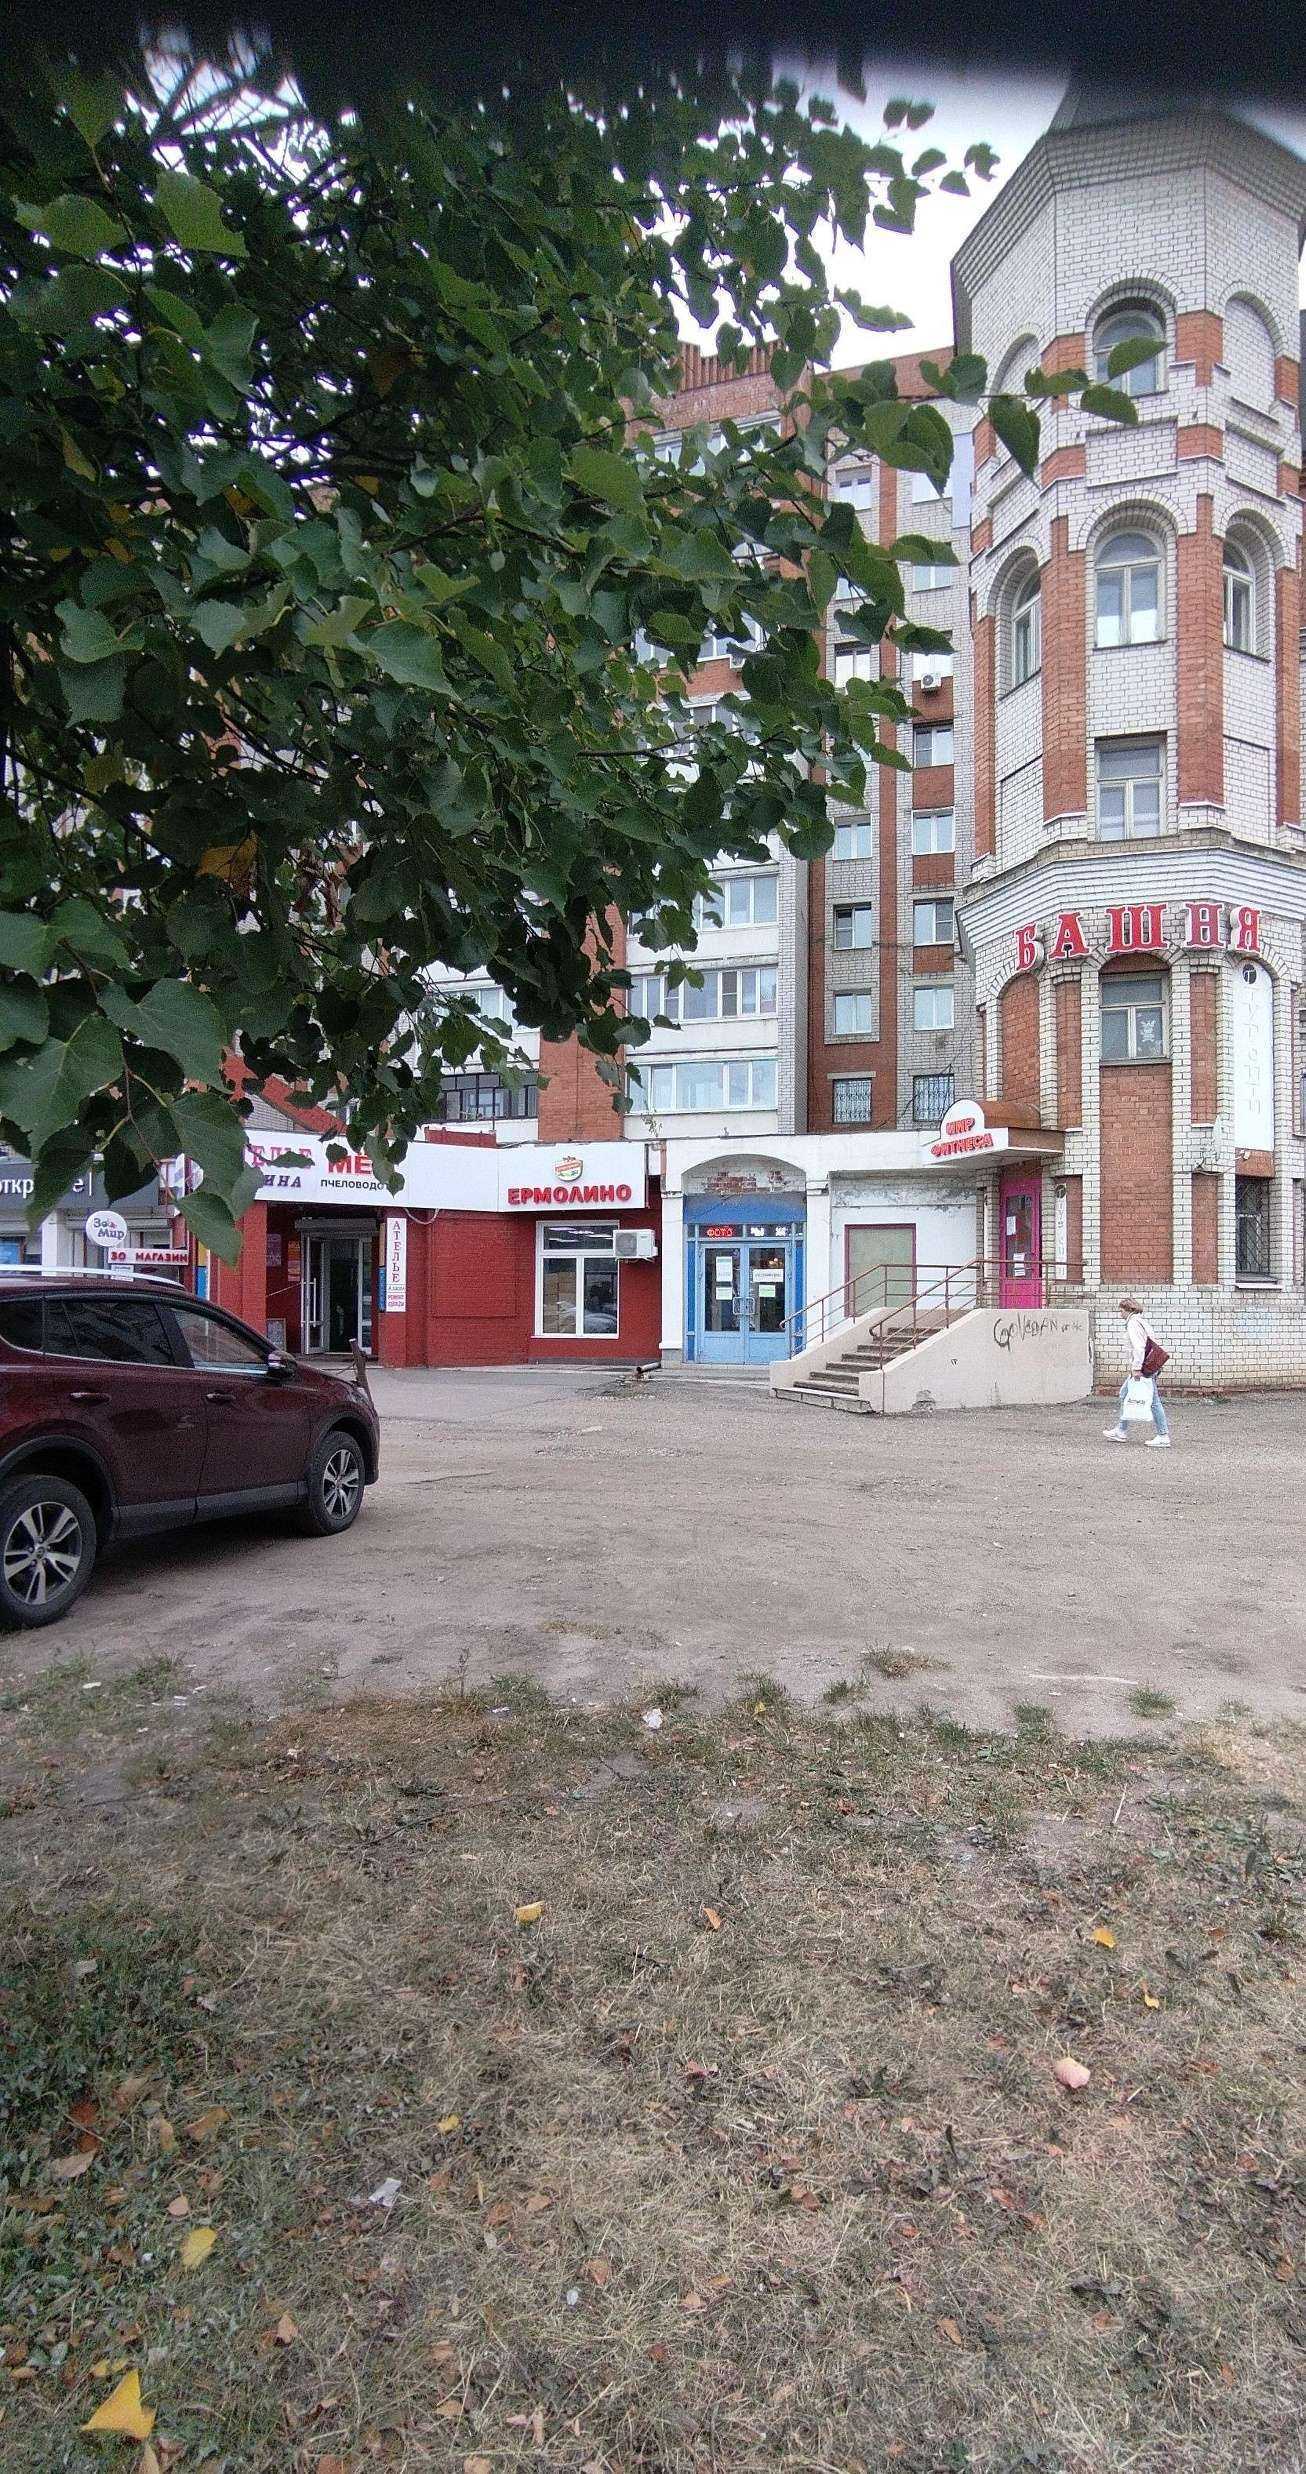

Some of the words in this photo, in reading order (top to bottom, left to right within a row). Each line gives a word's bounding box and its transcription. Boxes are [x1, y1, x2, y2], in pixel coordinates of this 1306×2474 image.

[1014, 902, 1261, 974] БАШНЯ
[946, 1118, 976, 1136] МИР
[931, 1133, 994, 1158] ФИТНЕСА
[507, 1184, 632, 1205] ЕРМОЛИНО
[135, 1252, 188, 1263] МАГАЗИН
[392, 1220, 402, 1283] АТЕЛЬЕ
